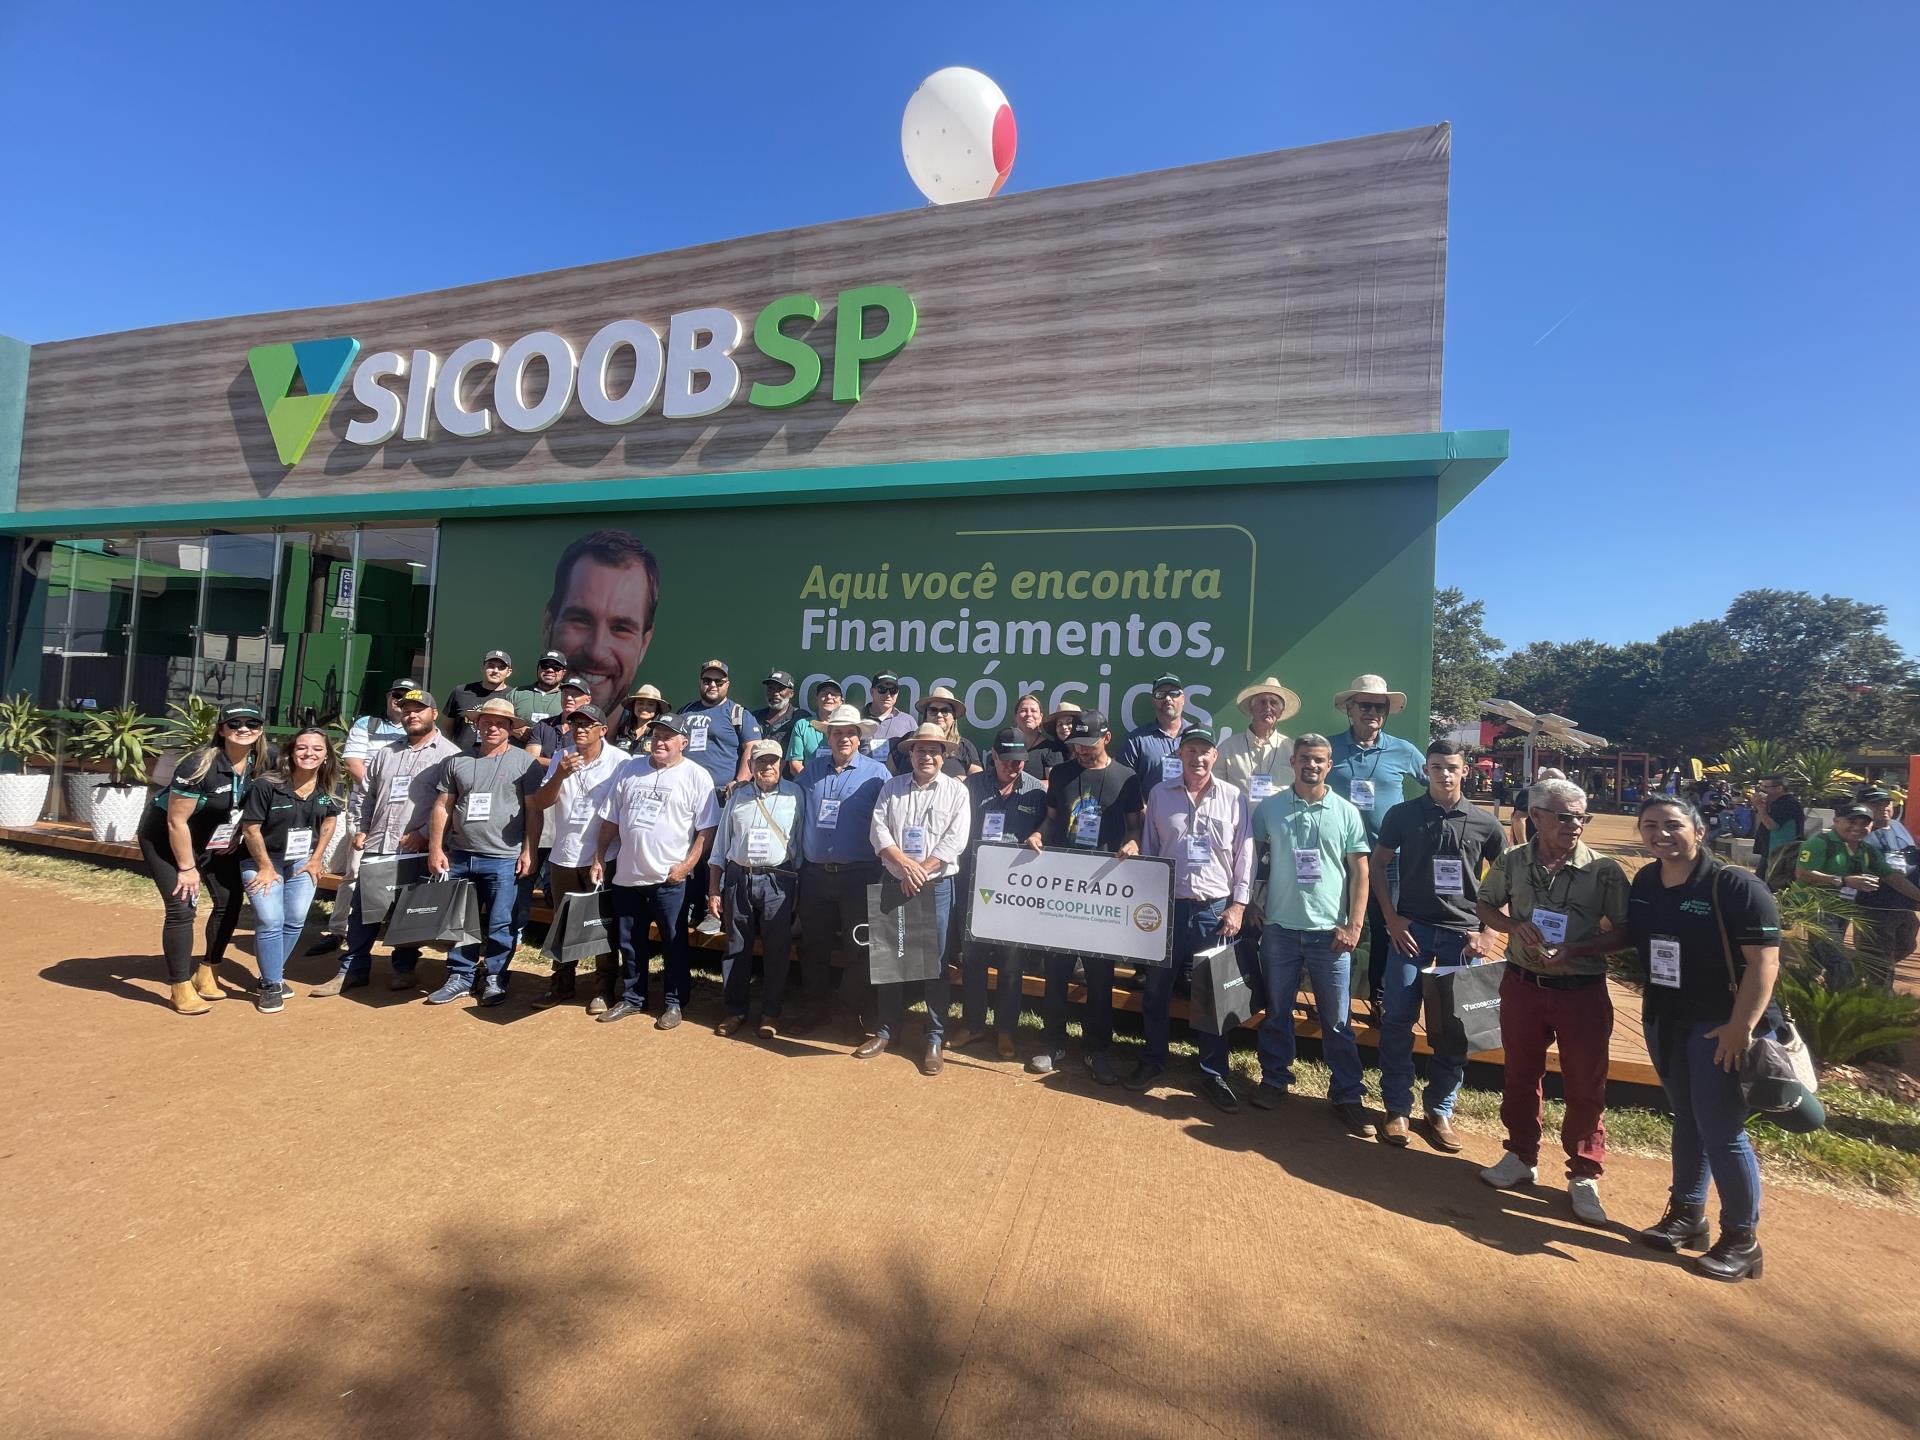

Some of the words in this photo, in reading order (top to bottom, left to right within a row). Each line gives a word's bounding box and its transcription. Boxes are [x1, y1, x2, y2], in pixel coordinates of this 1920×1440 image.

[344, 307, 743, 446] SICOOB
[748, 285, 918, 410] SP
[800, 563, 890, 608] Aqui
[901, 562, 998, 600] você
[1010, 563, 1222, 600] encontra
[801, 607, 1225, 666] Financiamentos,
[1007, 872, 1134, 898] COOPERADO
